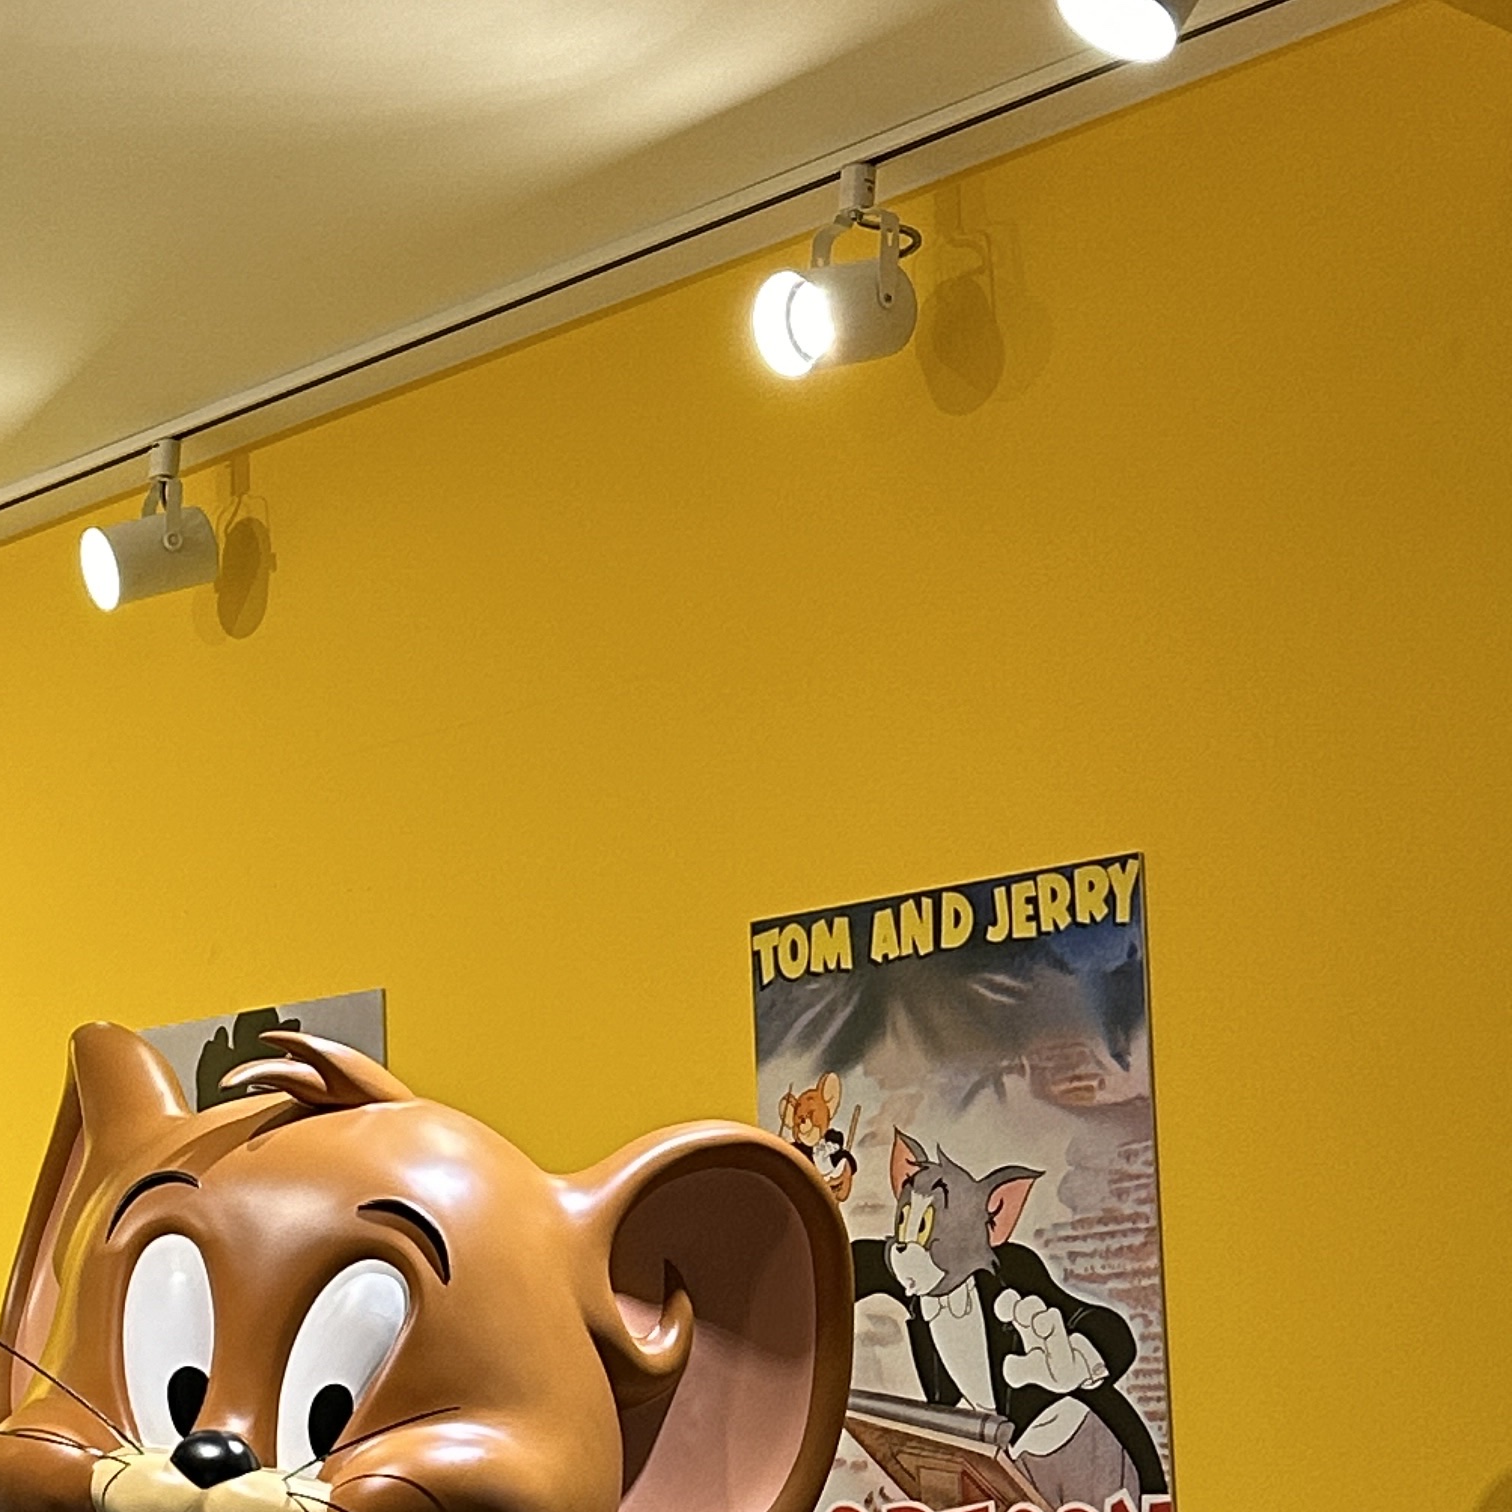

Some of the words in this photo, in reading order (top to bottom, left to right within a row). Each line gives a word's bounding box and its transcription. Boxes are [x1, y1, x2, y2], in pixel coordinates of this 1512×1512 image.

[752, 916, 853, 985] TOM
[869, 892, 974, 963] AND
[986, 858, 1140, 943] JERRY
